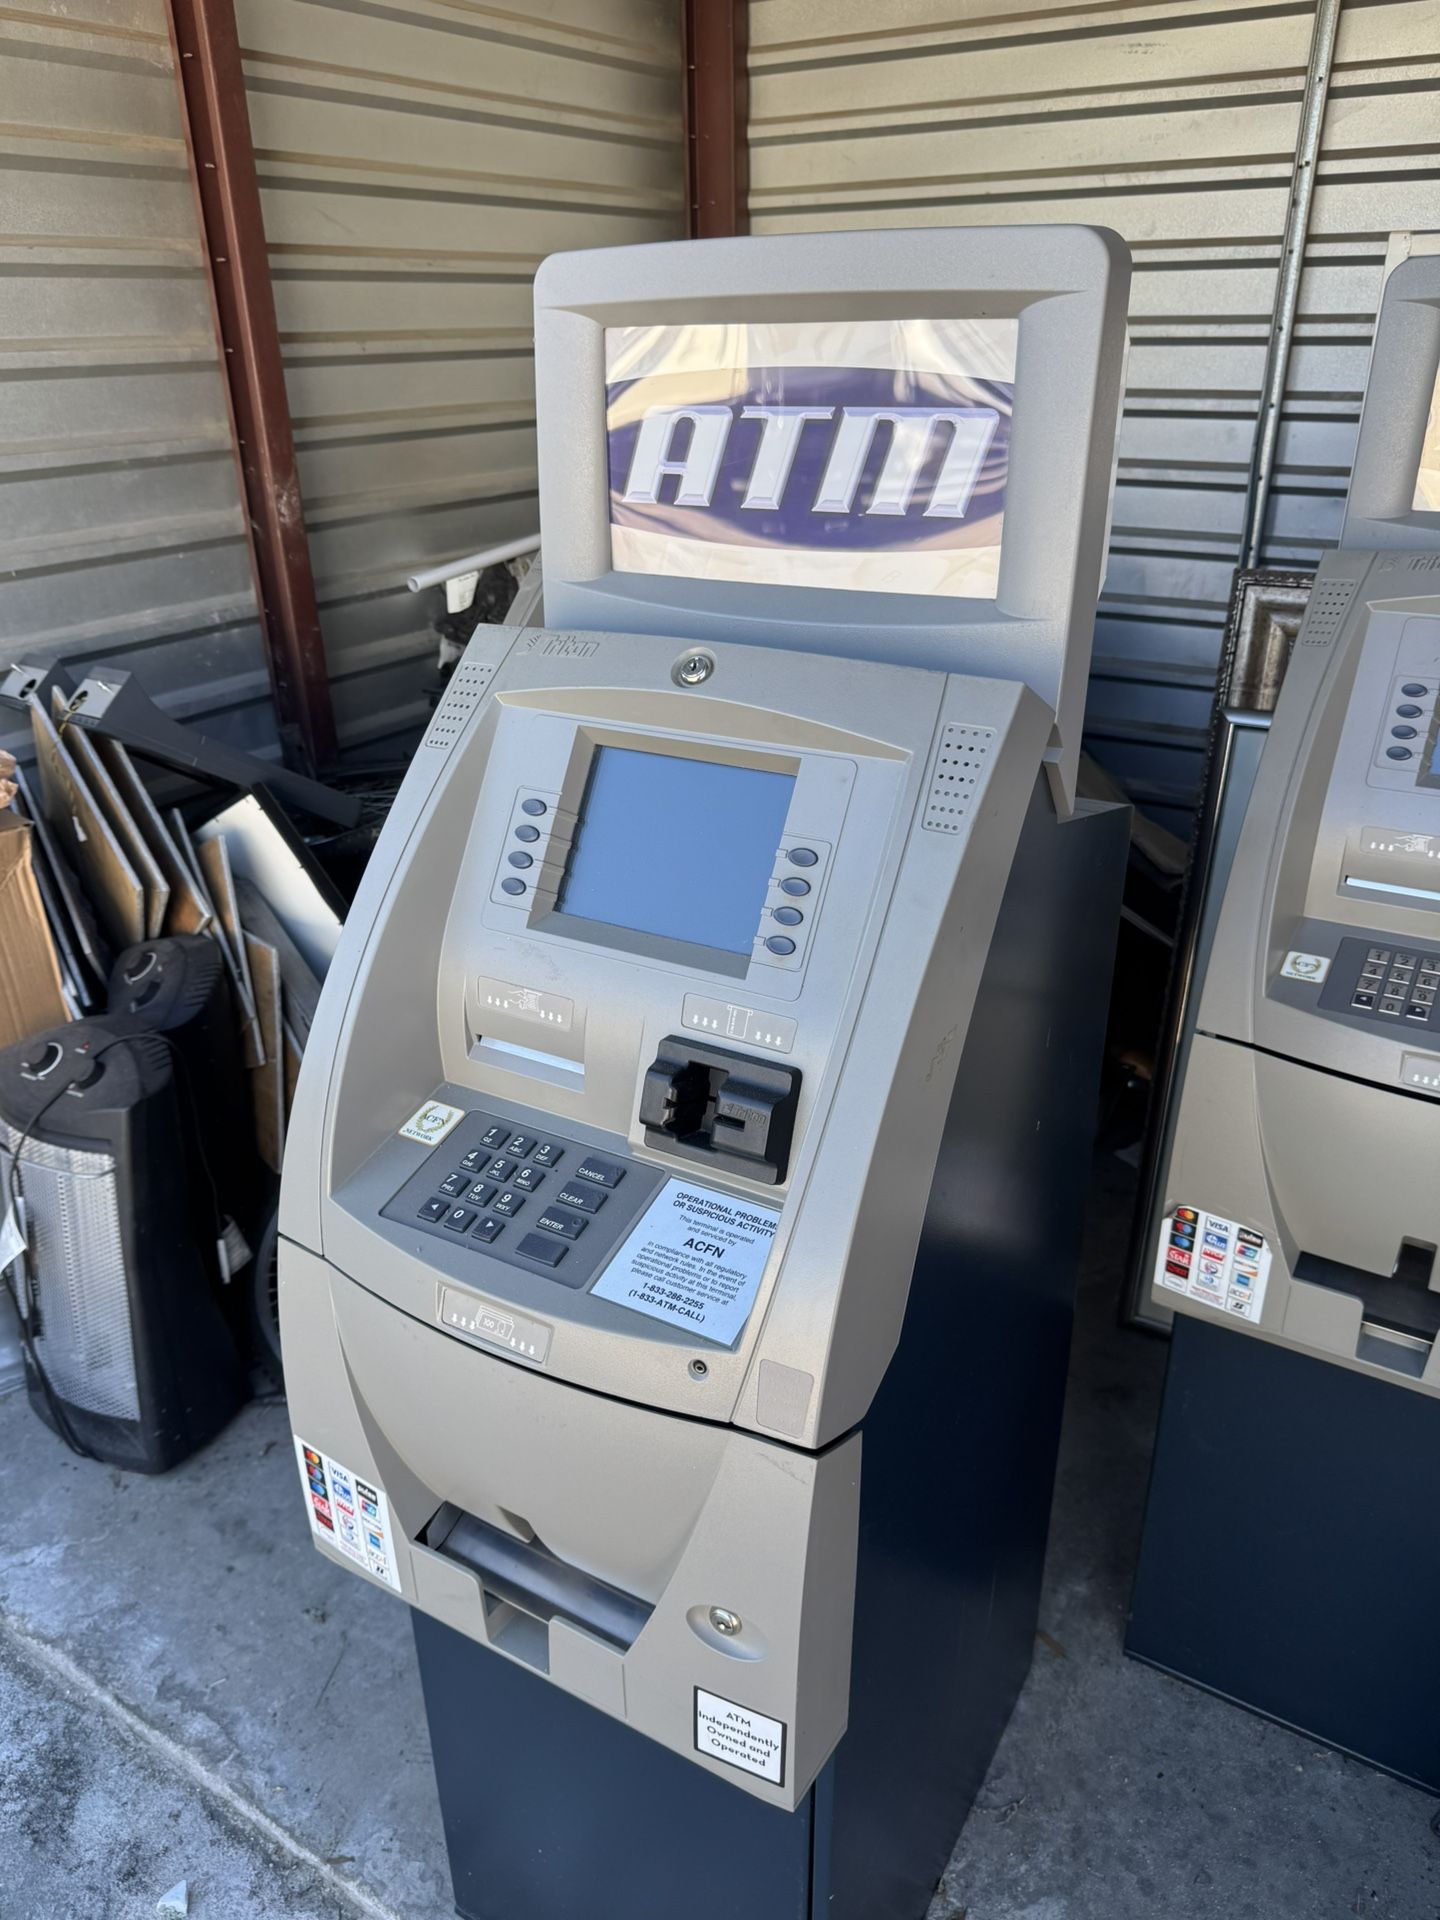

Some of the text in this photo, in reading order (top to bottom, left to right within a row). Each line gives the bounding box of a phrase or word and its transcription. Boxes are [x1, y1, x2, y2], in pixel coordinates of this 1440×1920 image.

[623, 406, 999, 518] ATM
[1400, 957, 1409, 965] 2
[1429, 962, 1436, 971] 3
[1423, 978, 1431, 986] 6
[1391, 987, 1400, 996] 8
[1418, 992, 1427, 1001] 9
[513, 1137, 524, 1146] 2
[467, 1151, 478, 1160] 4
[540, 1145, 551, 1154] 3
[494, 1160, 506, 1169] 5
[446, 1174, 458, 1182] 7
[521, 1169, 532, 1178] 6
[578, 1167, 605, 1181] CANCEL
[441, 1183, 454, 1191] PRS
[473, 1184, 484, 1193] 8
[468, 1193, 481, 1201] TUV
[501, 1194, 512, 1203] 9
[559, 1192, 584, 1205] CLEAR
[676, 1192, 733, 1216] OPERATIONAL
[453, 1210, 464, 1218] 0
[495, 1203, 511, 1211] WXY
[539, 1217, 565, 1231] ENTER
[673, 1200, 776, 1238] OR SUSPICIOUS ACTIVITY
[1209, 1219, 1229, 1232] VISA
[679, 1214, 692, 1223] This
[692, 1219, 719, 1232] terminal
[725, 1231, 755, 1245] operated
[687, 1226, 737, 1247] and serviced by
[683, 1237, 725, 1258] ACFN
[654, 1243, 690, 1260] compliance
[691, 1256, 704, 1264] with
[714, 1264, 747, 1280] regulatory
[654, 1251, 679, 1263] network
[718, 1274, 738, 1284] event
[631, 1259, 664, 1274] suspicious
[664, 1271, 688, 1283] activity
[695, 1281, 708, 1290] this
[636, 1253, 672, 1269] operational
[671, 1265, 702, 1279] problems
[718, 1282, 739, 1293] report
[631, 1267, 653, 1279] please
[665, 1279, 697, 1294] customer
[696, 1290, 721, 1303] service
[642, 1282, 705, 1310] 1-833-286-2255
[628, 1289, 706, 1324] (1-833-ATM-CALL)
[332, 1467, 349, 1482] VISA
[726, 1712, 751, 1727] ATM
[699, 1710, 779, 1751] Independently
[706, 1725, 771, 1758] Owned and
[711, 1738, 766, 1767] Operated
